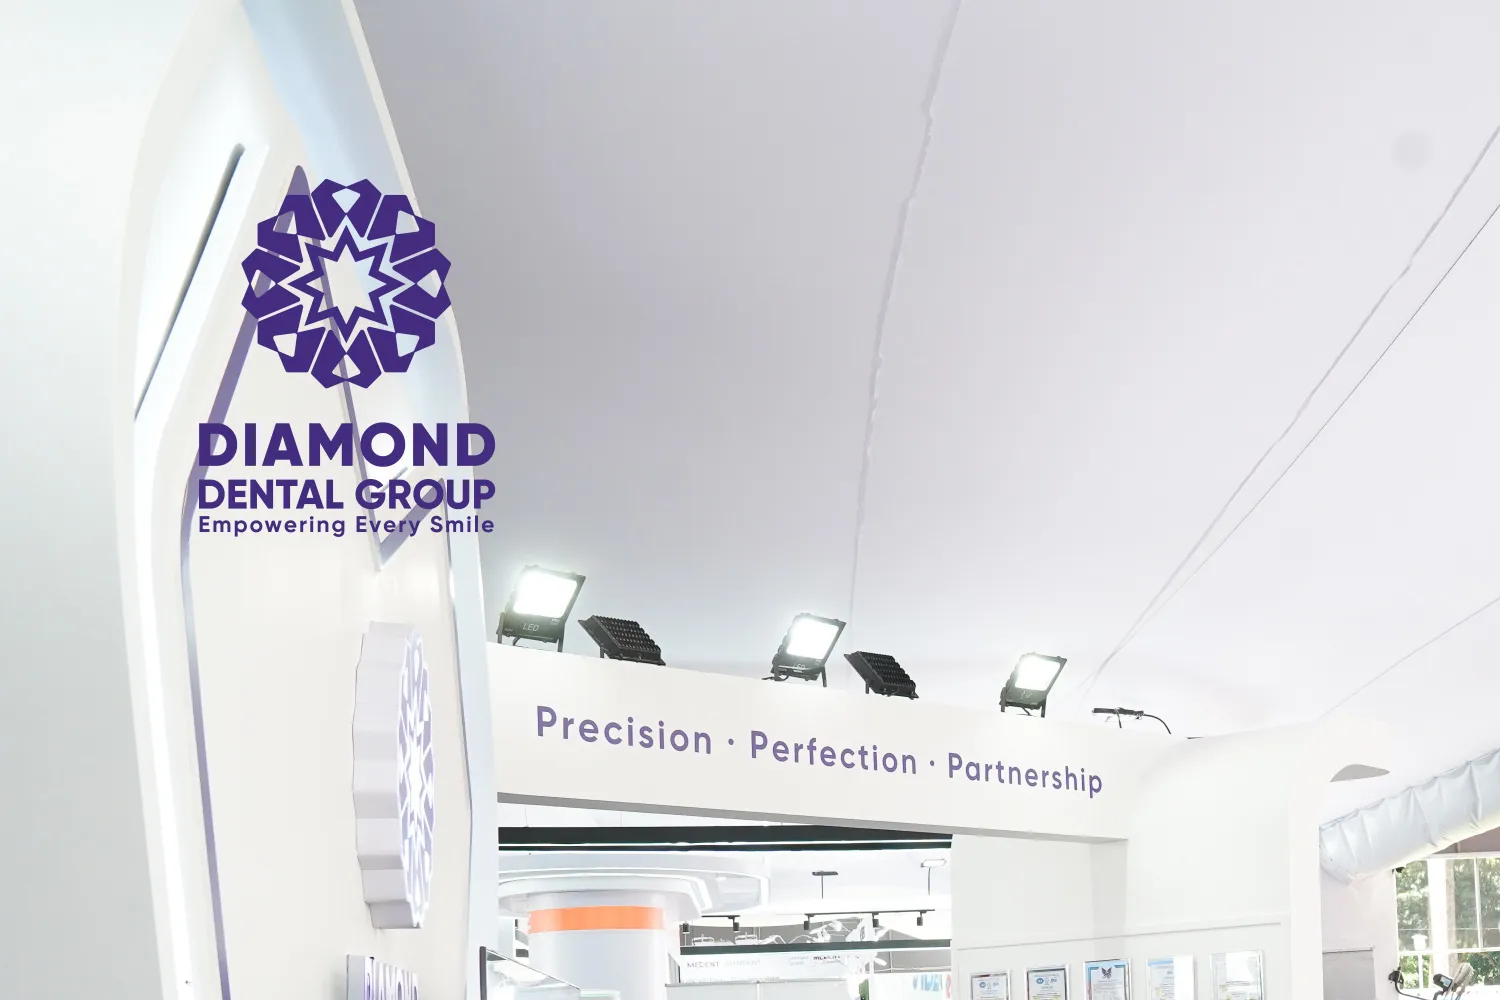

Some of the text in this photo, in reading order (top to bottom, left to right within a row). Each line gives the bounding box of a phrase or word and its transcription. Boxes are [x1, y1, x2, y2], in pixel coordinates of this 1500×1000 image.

[536, 705, 1103, 799] Precision Perfection Partnership
